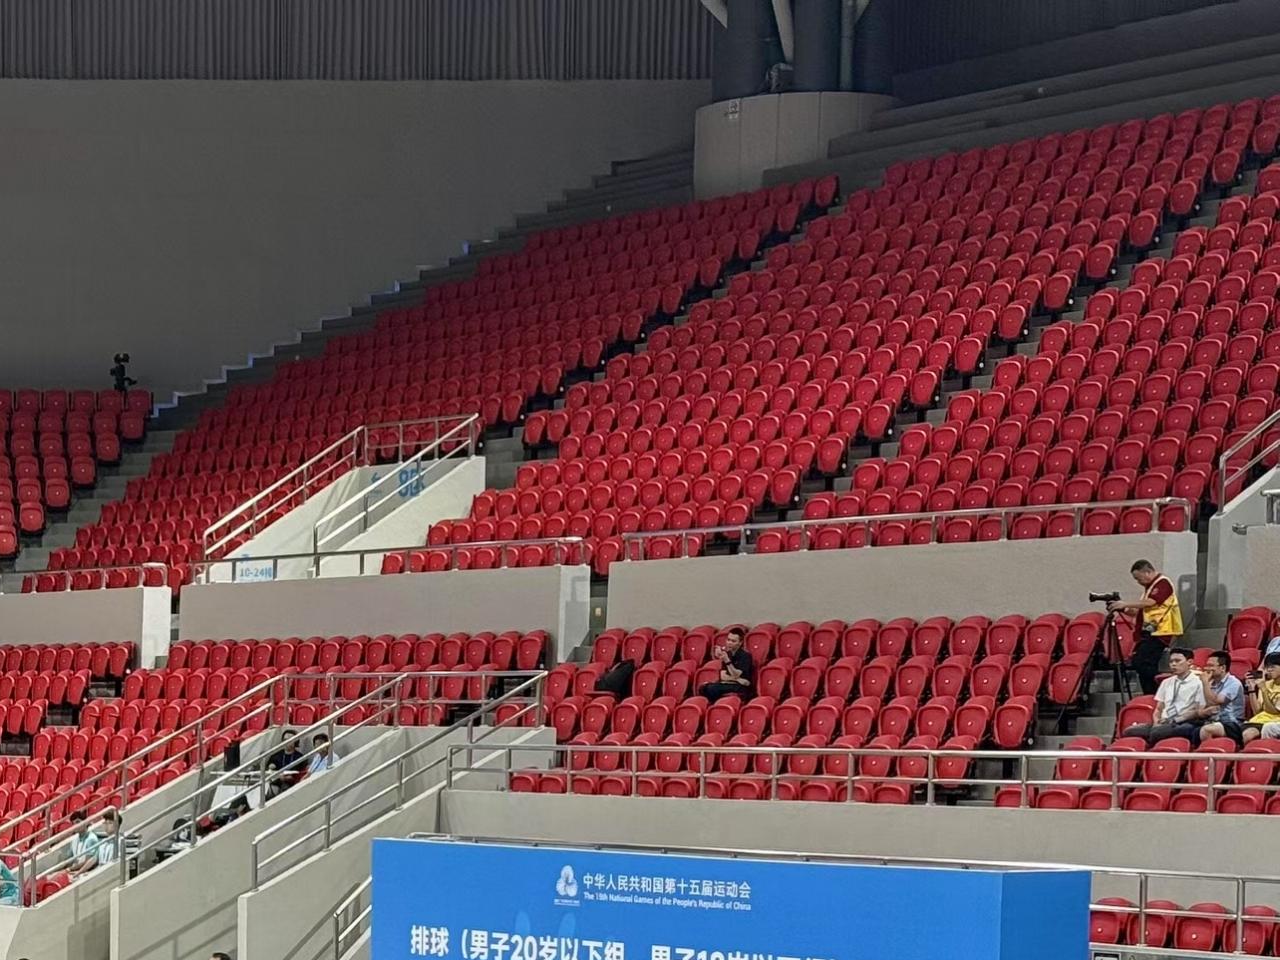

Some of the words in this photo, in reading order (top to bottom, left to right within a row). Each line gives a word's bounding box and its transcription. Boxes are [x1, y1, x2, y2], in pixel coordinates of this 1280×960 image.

[583, 871, 751, 899] 中华人民共和国第十五届运动会
